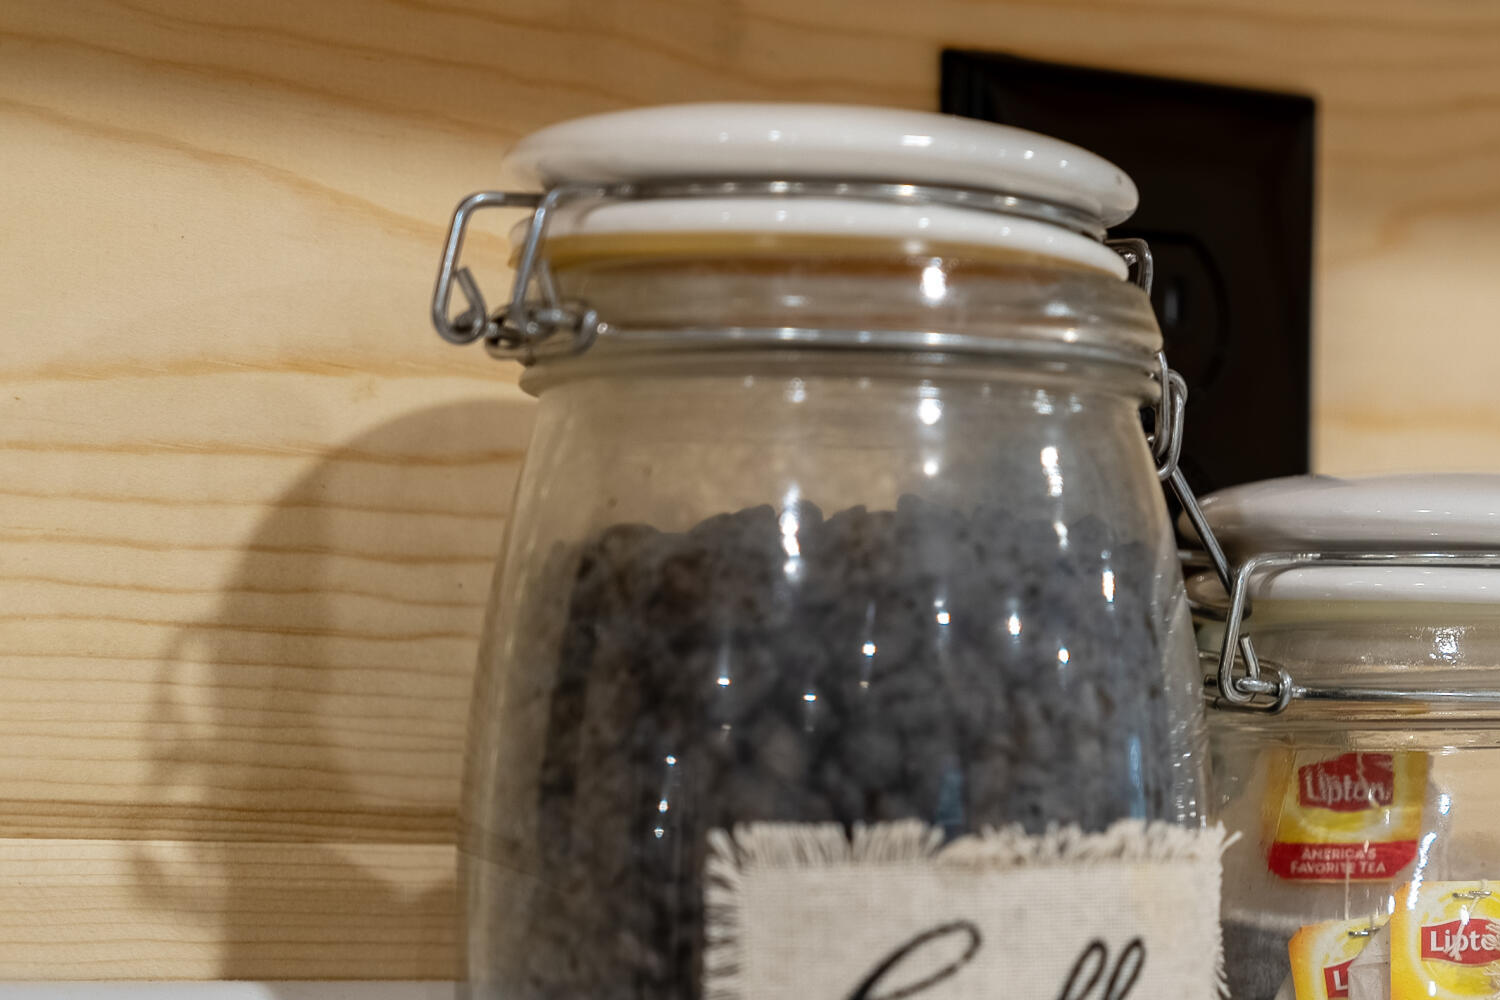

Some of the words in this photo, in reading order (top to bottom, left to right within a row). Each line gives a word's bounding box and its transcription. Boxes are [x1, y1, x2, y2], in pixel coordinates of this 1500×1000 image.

[1304, 766, 1386, 806] Lipton
[1301, 846, 1377, 861] AMERICA'S
[1290, 860, 1353, 875] FAVORITE
[1360, 860, 1386, 873] TEA
